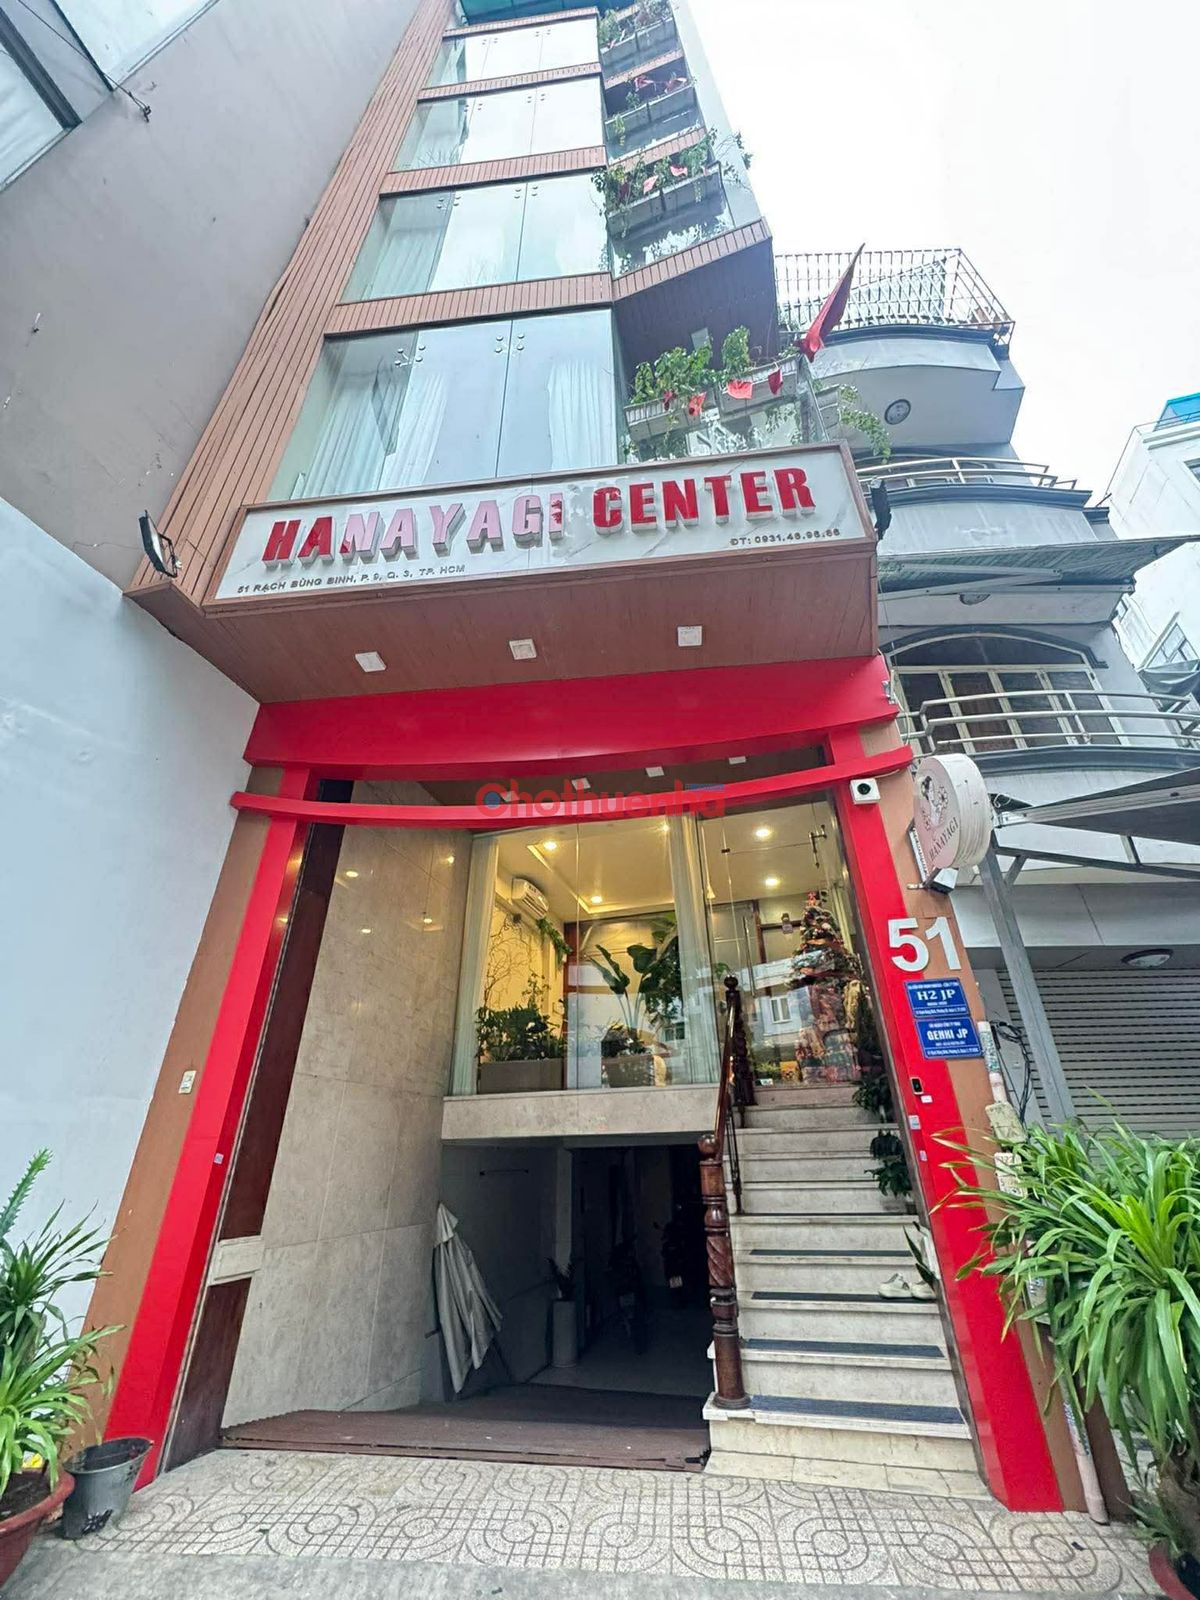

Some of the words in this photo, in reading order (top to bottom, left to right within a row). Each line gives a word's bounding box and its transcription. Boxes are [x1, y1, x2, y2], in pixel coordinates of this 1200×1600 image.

[261, 494, 563, 569] HANAYAGI
[592, 467, 817, 535] CENTER
[237, 585, 250, 594] 51
[439, 564, 466, 574] HCM
[928, 817, 960, 861] HANAYAGI
[887, 916, 962, 972] 51
[917, 990, 938, 1000] H2
[940, 989, 956, 1001] JP
[956, 1028, 969, 1039] JP
